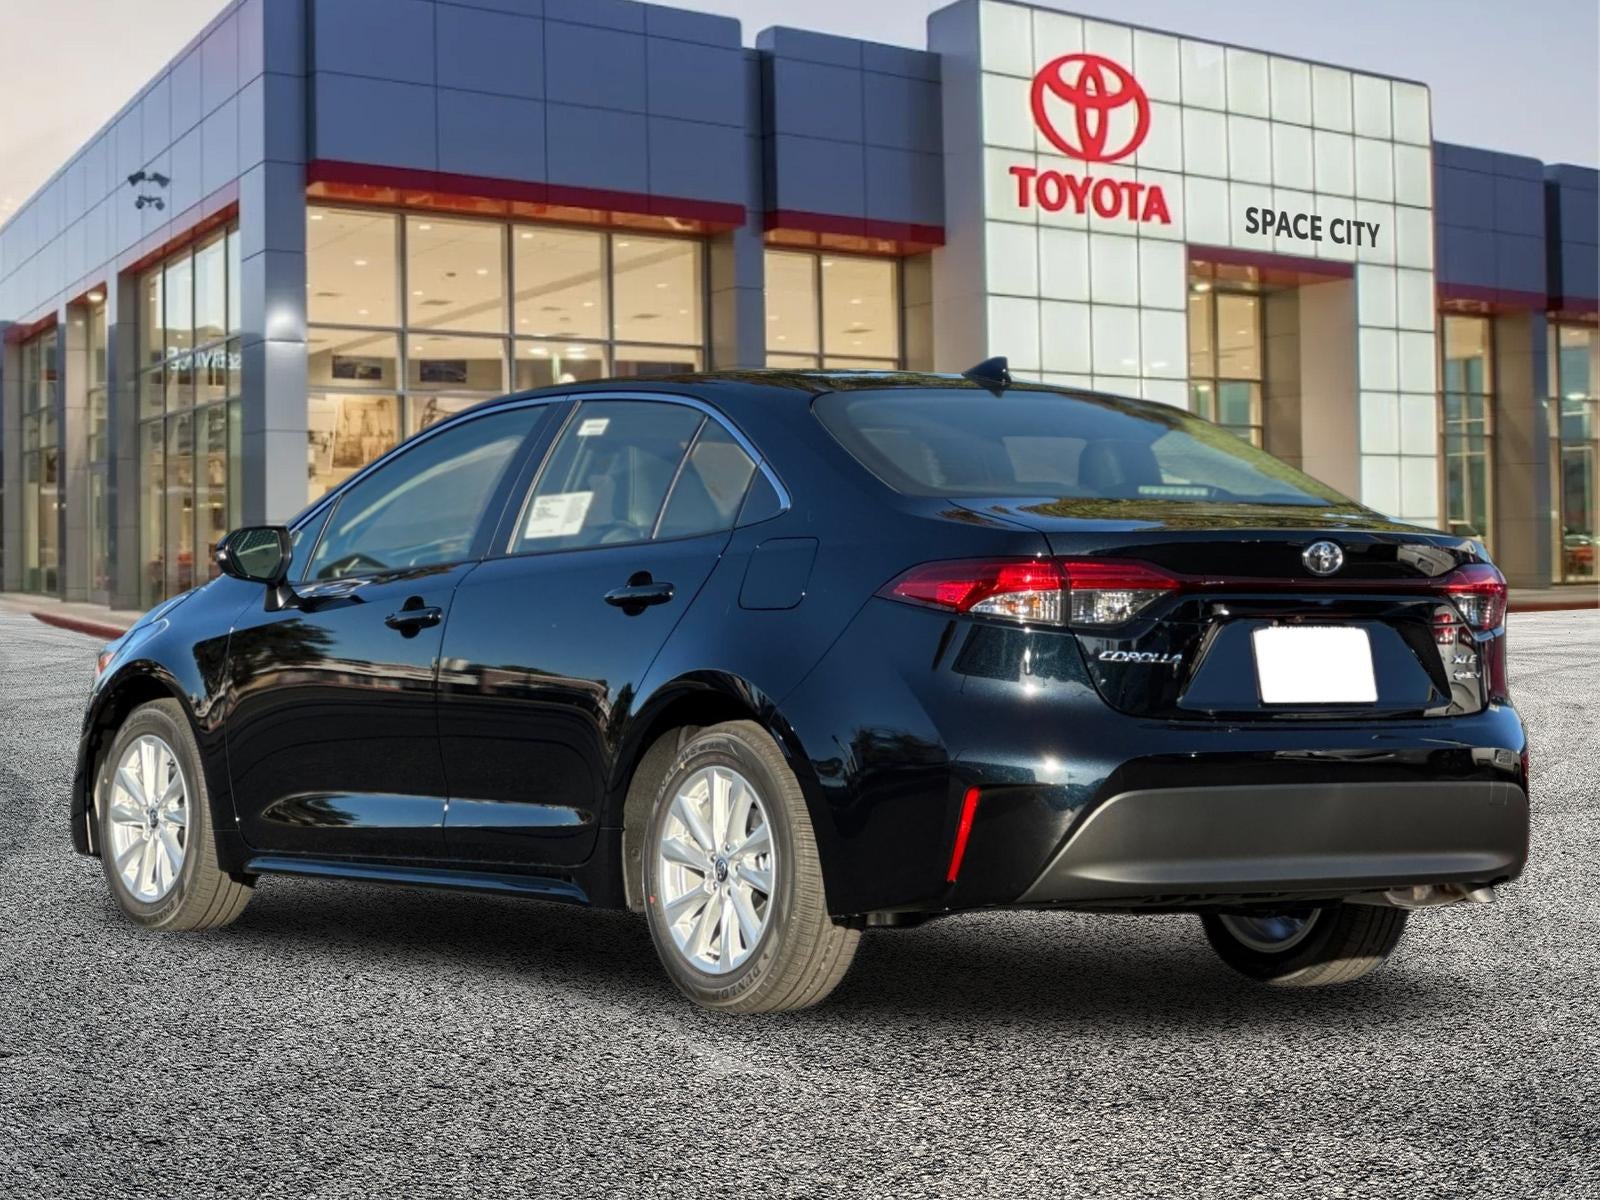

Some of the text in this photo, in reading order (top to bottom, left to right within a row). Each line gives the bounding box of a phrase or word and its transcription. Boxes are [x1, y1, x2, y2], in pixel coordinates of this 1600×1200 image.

[1009, 166, 1171, 225] TOYOTA
[1245, 207, 1381, 248] SPACE CITY
[1098, 650, 1183, 663] COROLLA
